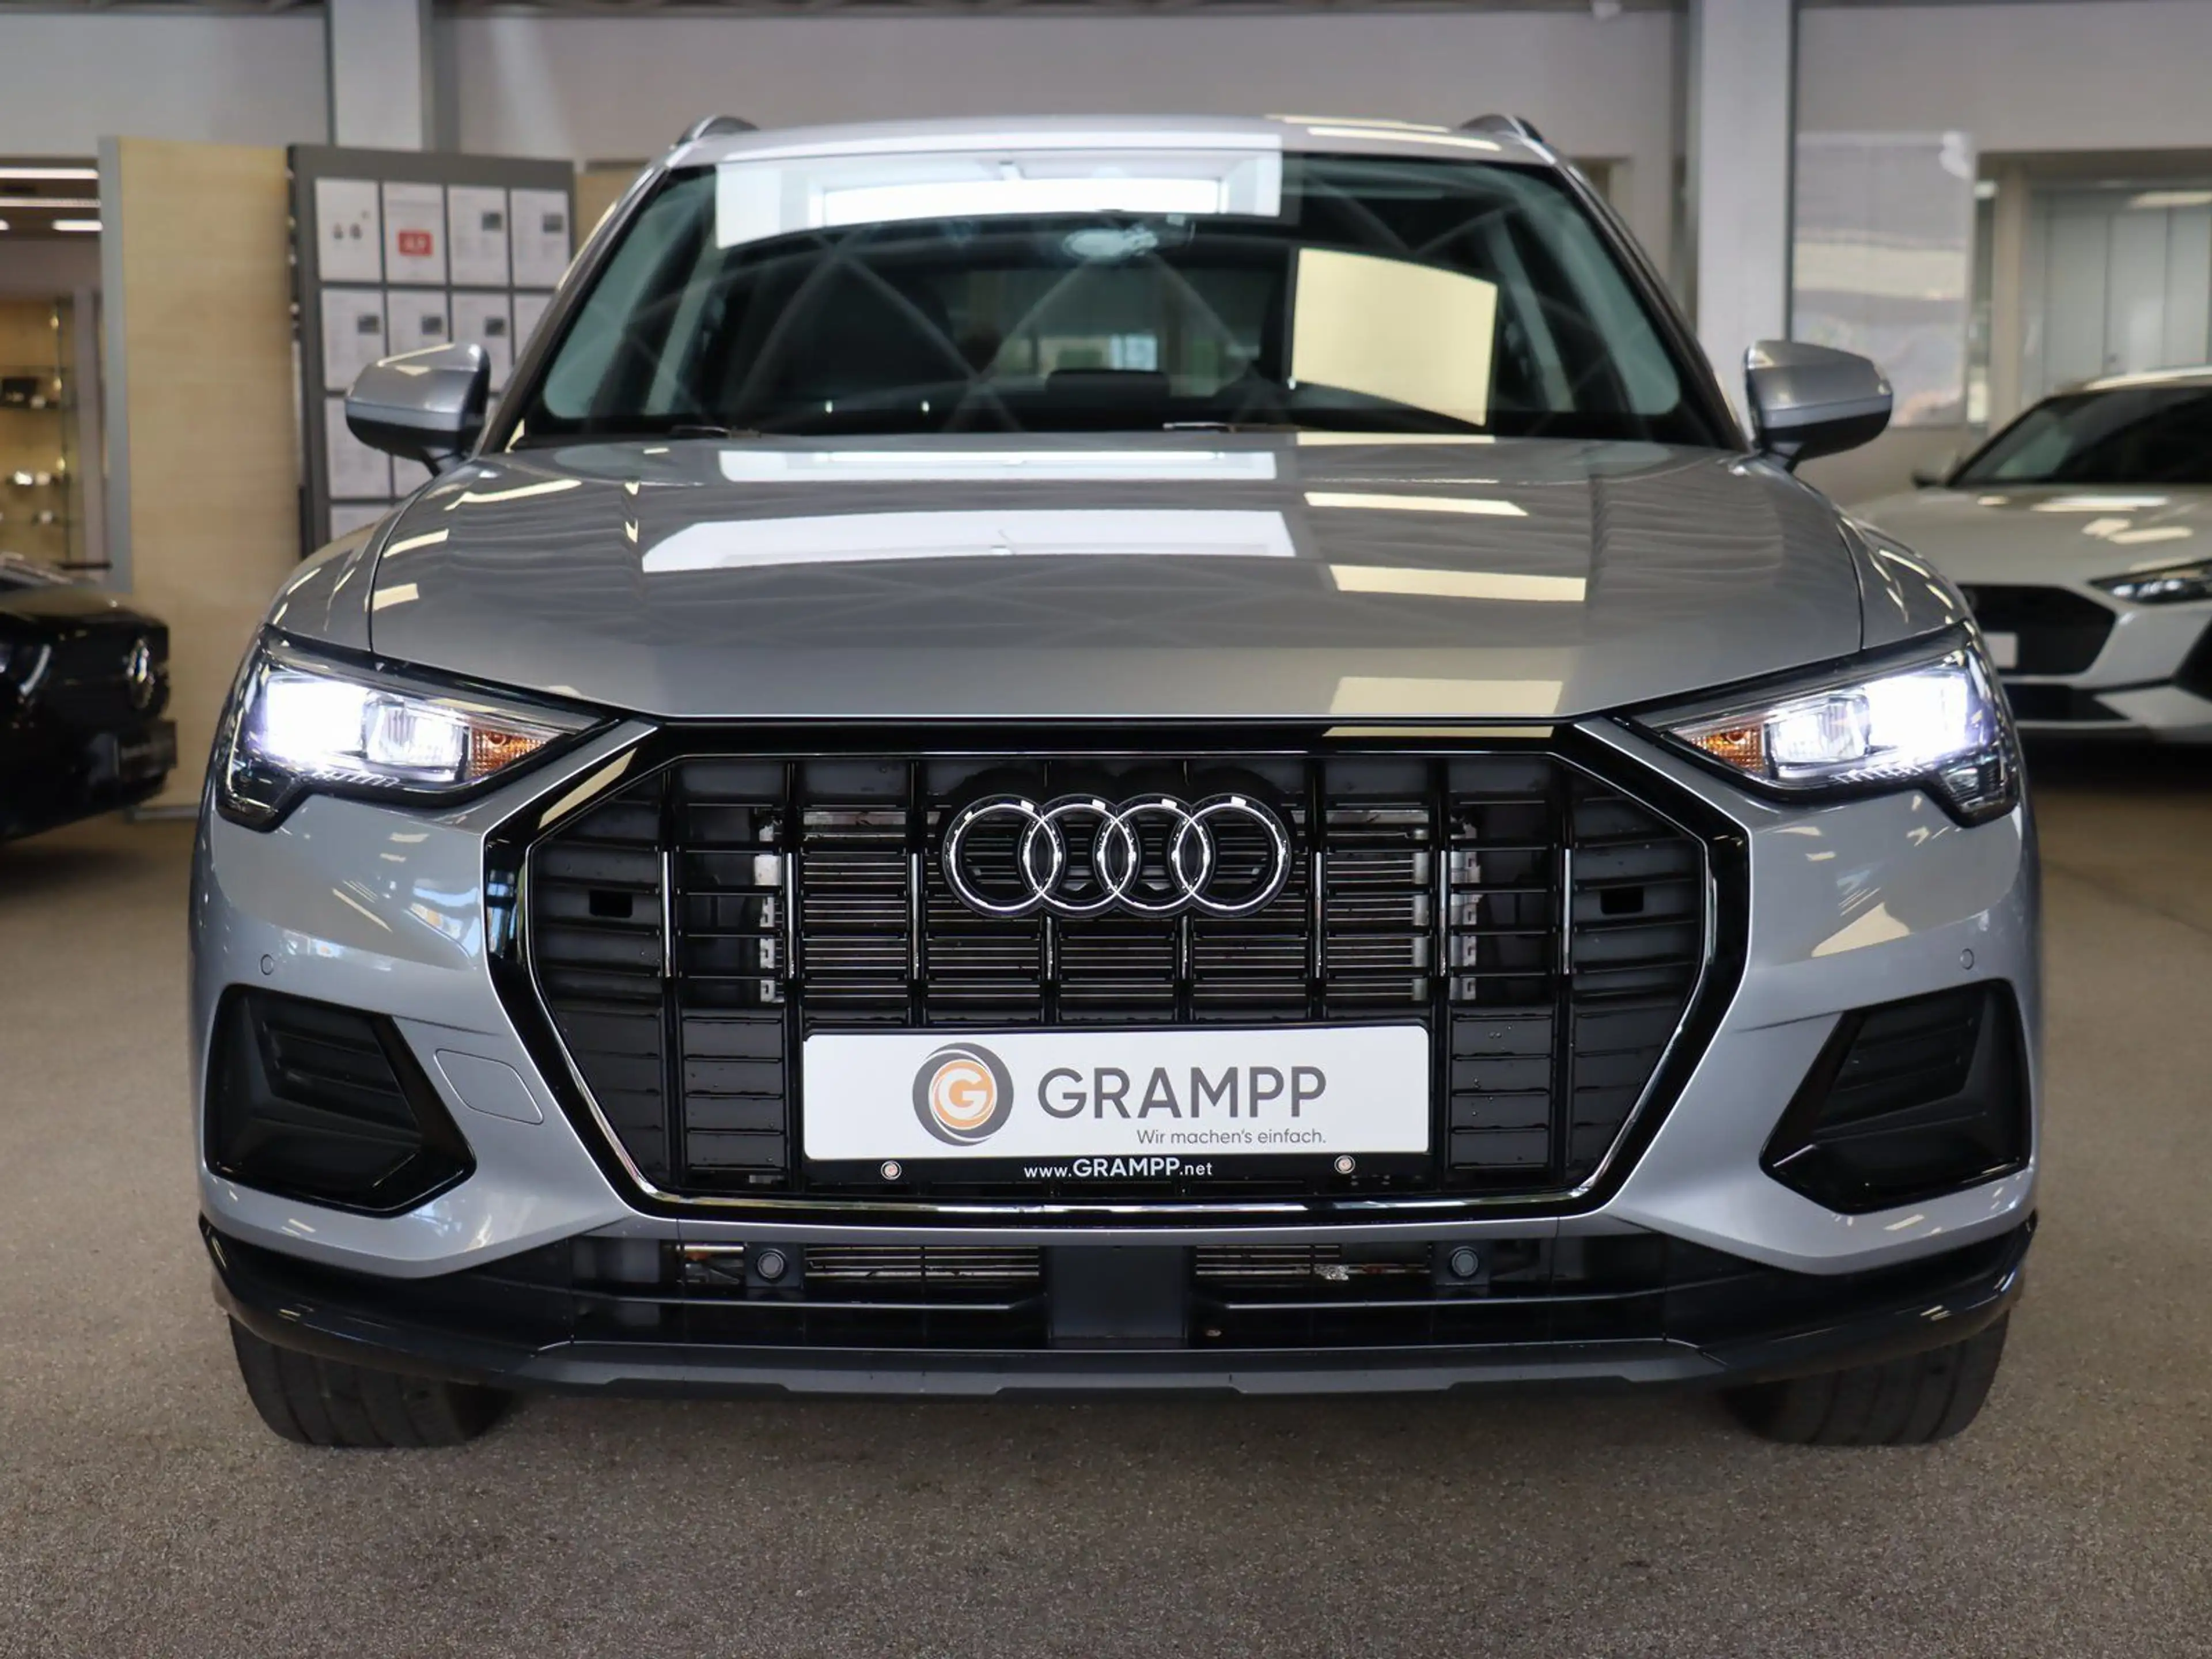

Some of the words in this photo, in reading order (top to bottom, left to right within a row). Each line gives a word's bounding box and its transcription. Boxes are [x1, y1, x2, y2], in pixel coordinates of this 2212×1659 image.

[938, 1067, 987, 1119] G
[1037, 1066, 1327, 1119] GRAMPP
[1137, 1130, 1166, 1144] Wir
[1257, 1128, 1327, 1144] einfach.
[1024, 1156, 1213, 1178] www.GRAMPP.net
